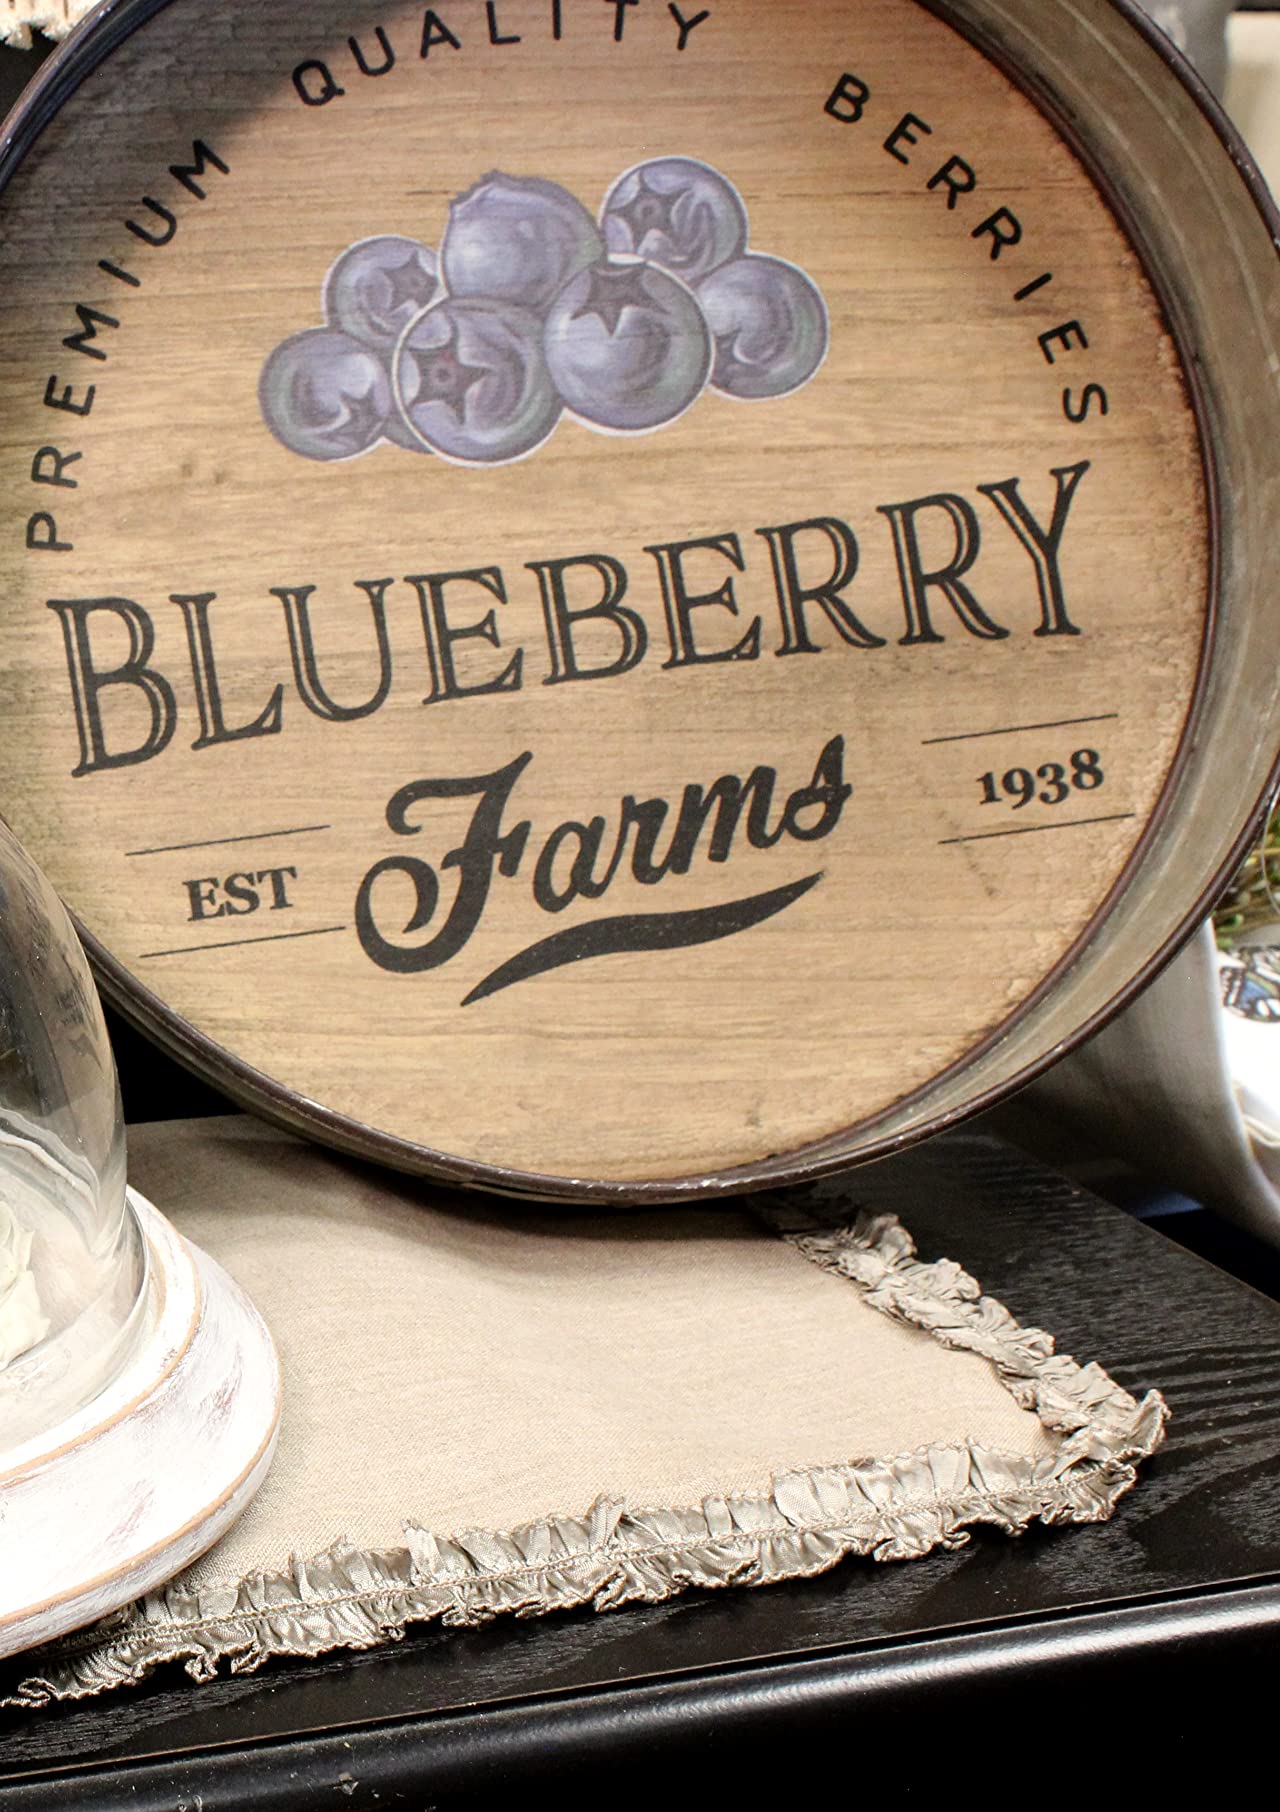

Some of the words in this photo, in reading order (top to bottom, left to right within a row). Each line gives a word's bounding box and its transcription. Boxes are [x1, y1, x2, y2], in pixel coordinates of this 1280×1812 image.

[25, 138, 230, 552] PREMIUM
[291, 0, 710, 107] QUALITY
[823, 71, 1109, 424] BERRIES
[47, 461, 1090, 777] BLUEBERRY
[182, 865, 298, 923] EST
[976, 748, 1105, 810] 1938
[354, 733, 853, 975] Farms
